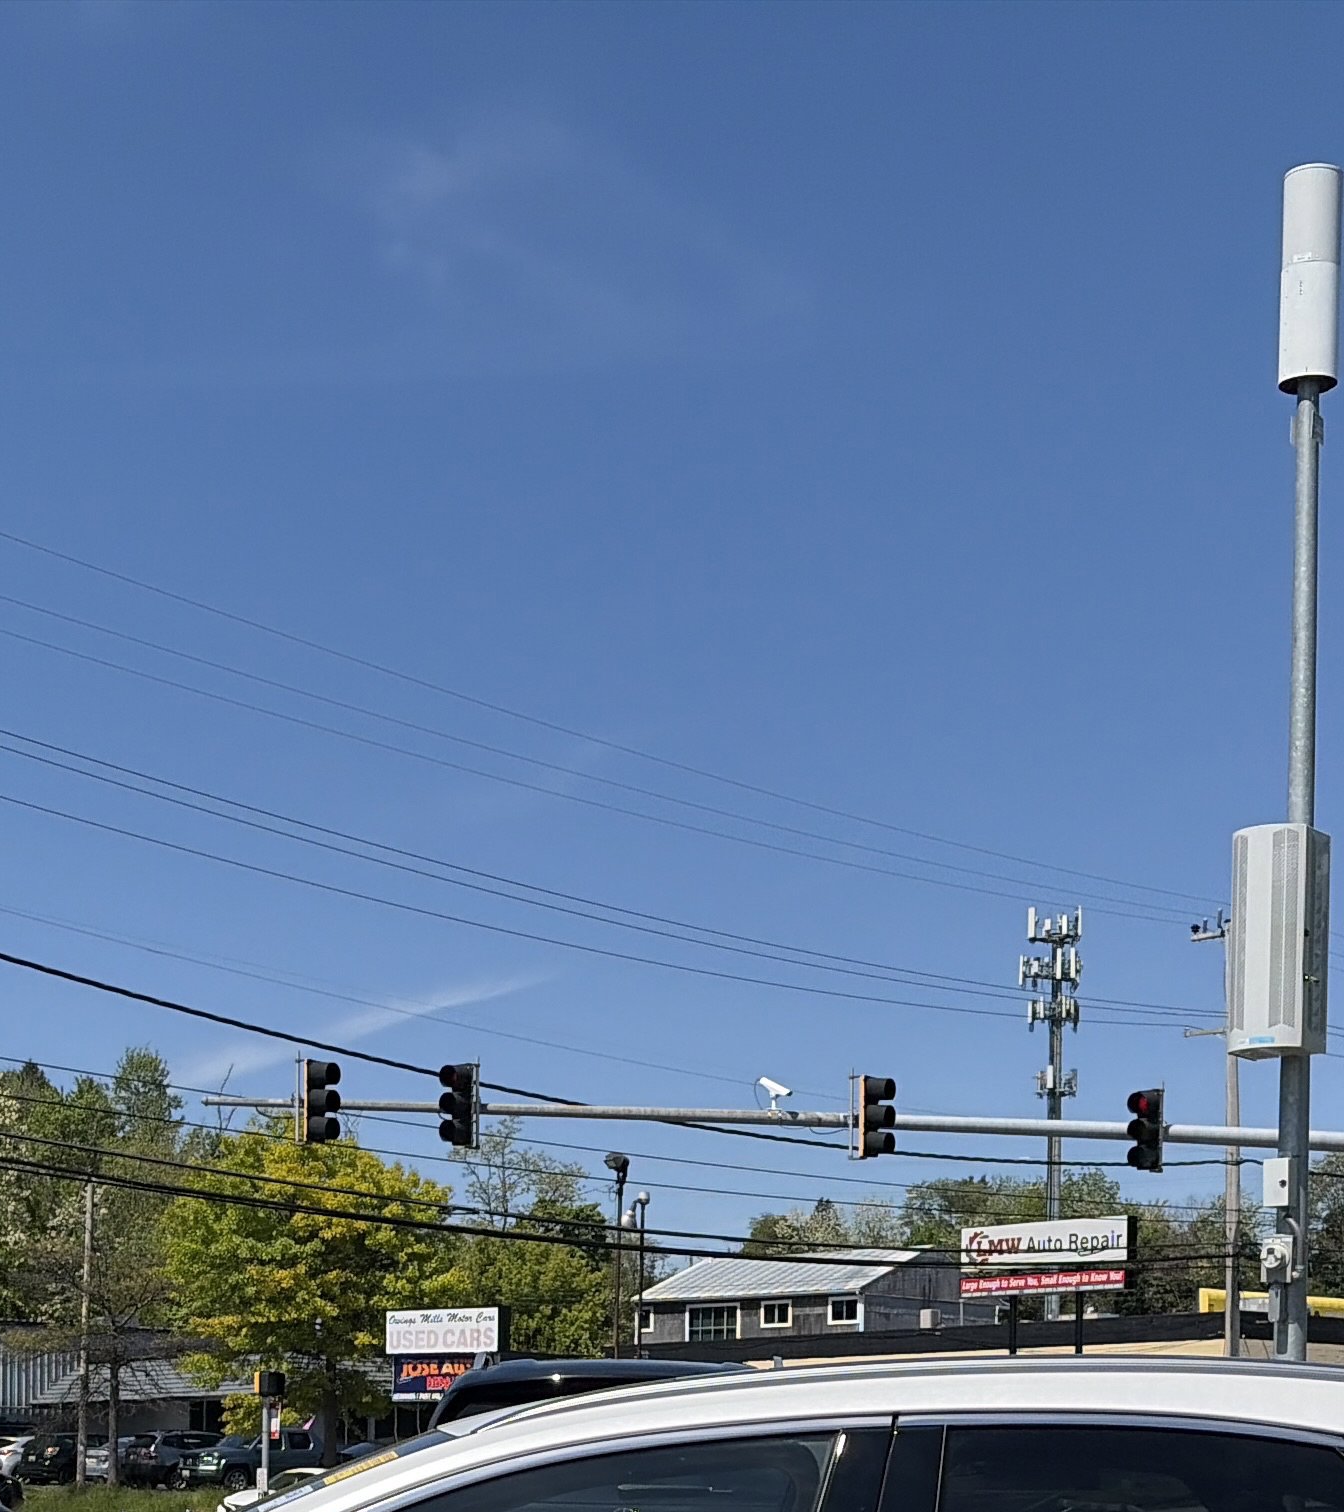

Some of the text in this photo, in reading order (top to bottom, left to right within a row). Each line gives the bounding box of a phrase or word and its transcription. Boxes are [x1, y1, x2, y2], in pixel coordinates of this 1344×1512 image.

[976, 1230, 1123, 1256] LMW Auto Repair
[979, 1278, 1001, 1291] Enough
[1002, 1278, 1008, 1288] to
[1009, 1278, 1026, 1288] Serve
[1041, 1274, 1058, 1286] Small
[1059, 1273, 1081, 1286] Enough
[1082, 1273, 1090, 1283] to
[1091, 1271, 1108, 1282] Know
[389, 1311, 496, 1327] Owings Mills Motor Cars
[389, 1327, 495, 1349] USED CARS
